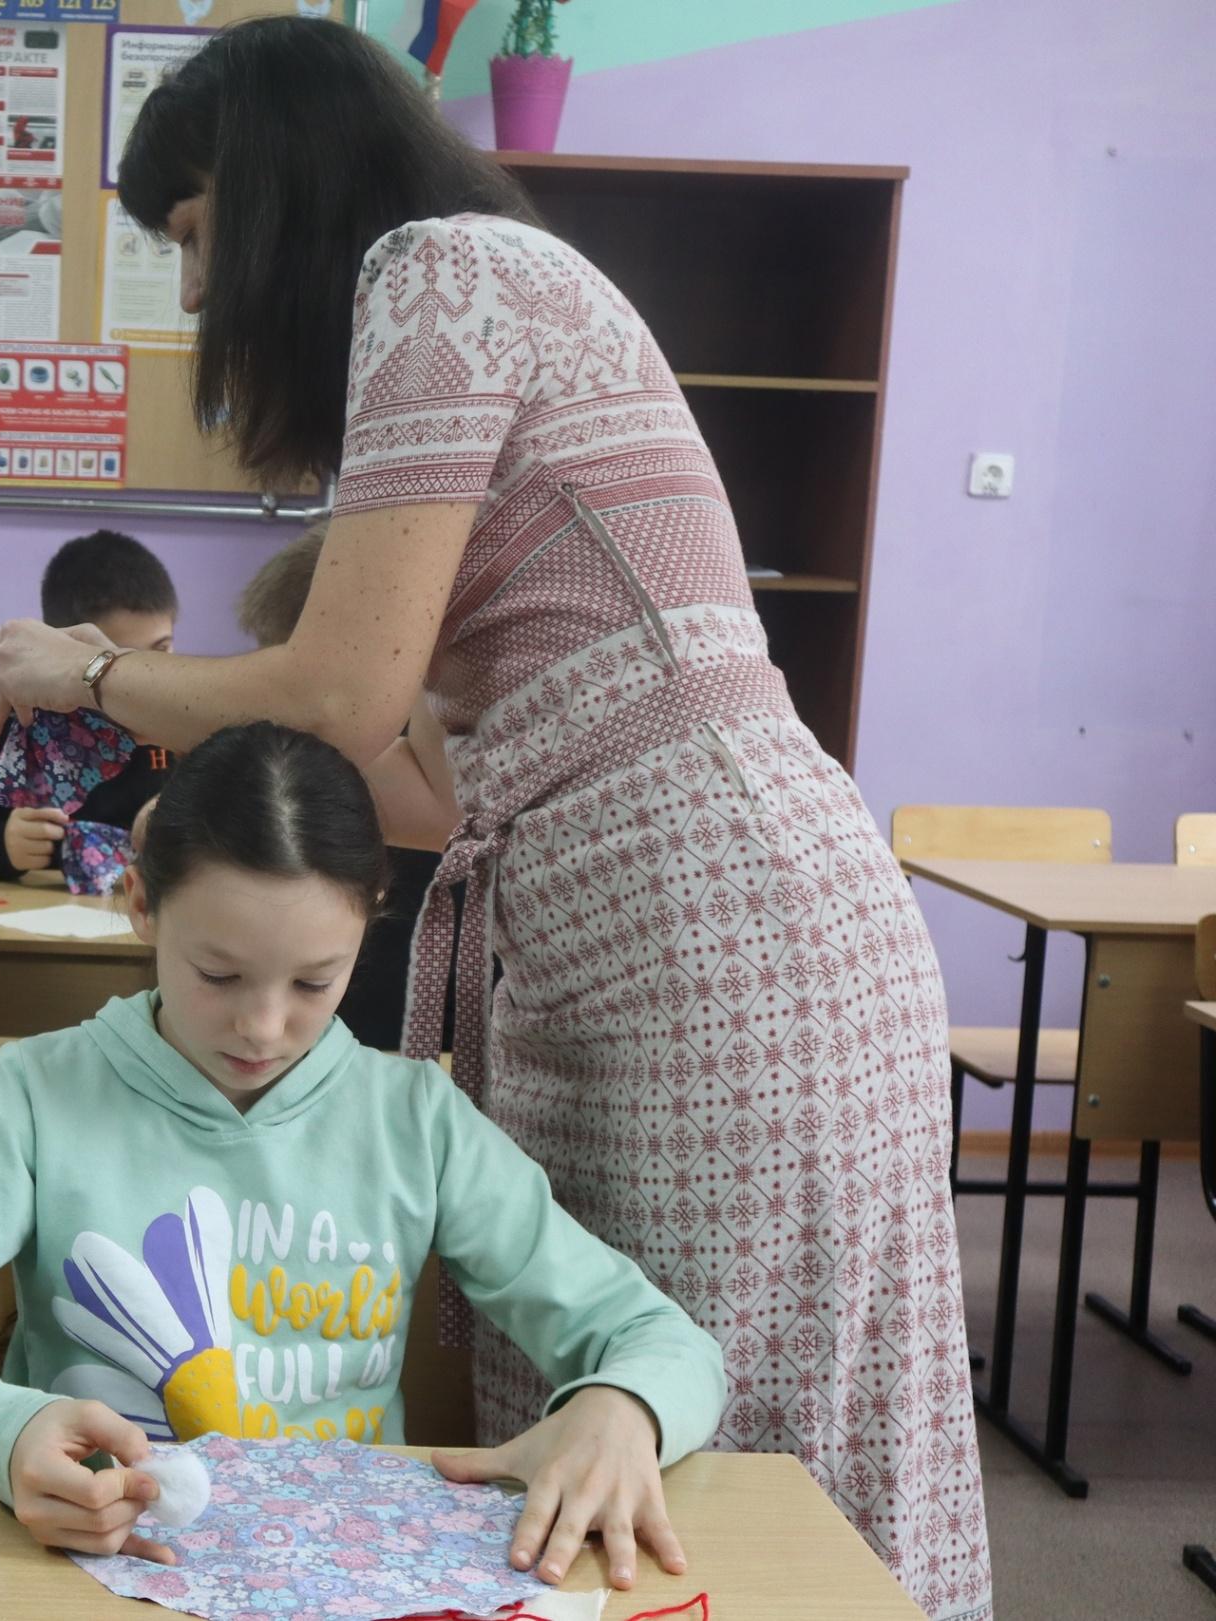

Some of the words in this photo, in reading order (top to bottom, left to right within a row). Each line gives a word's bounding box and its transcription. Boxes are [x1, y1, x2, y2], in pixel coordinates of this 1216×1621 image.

[237, 1199, 294, 1265] IN
[308, 1210, 337, 1263] A
[230, 1264, 402, 1340] World
[236, 1343, 342, 1404] FULL
